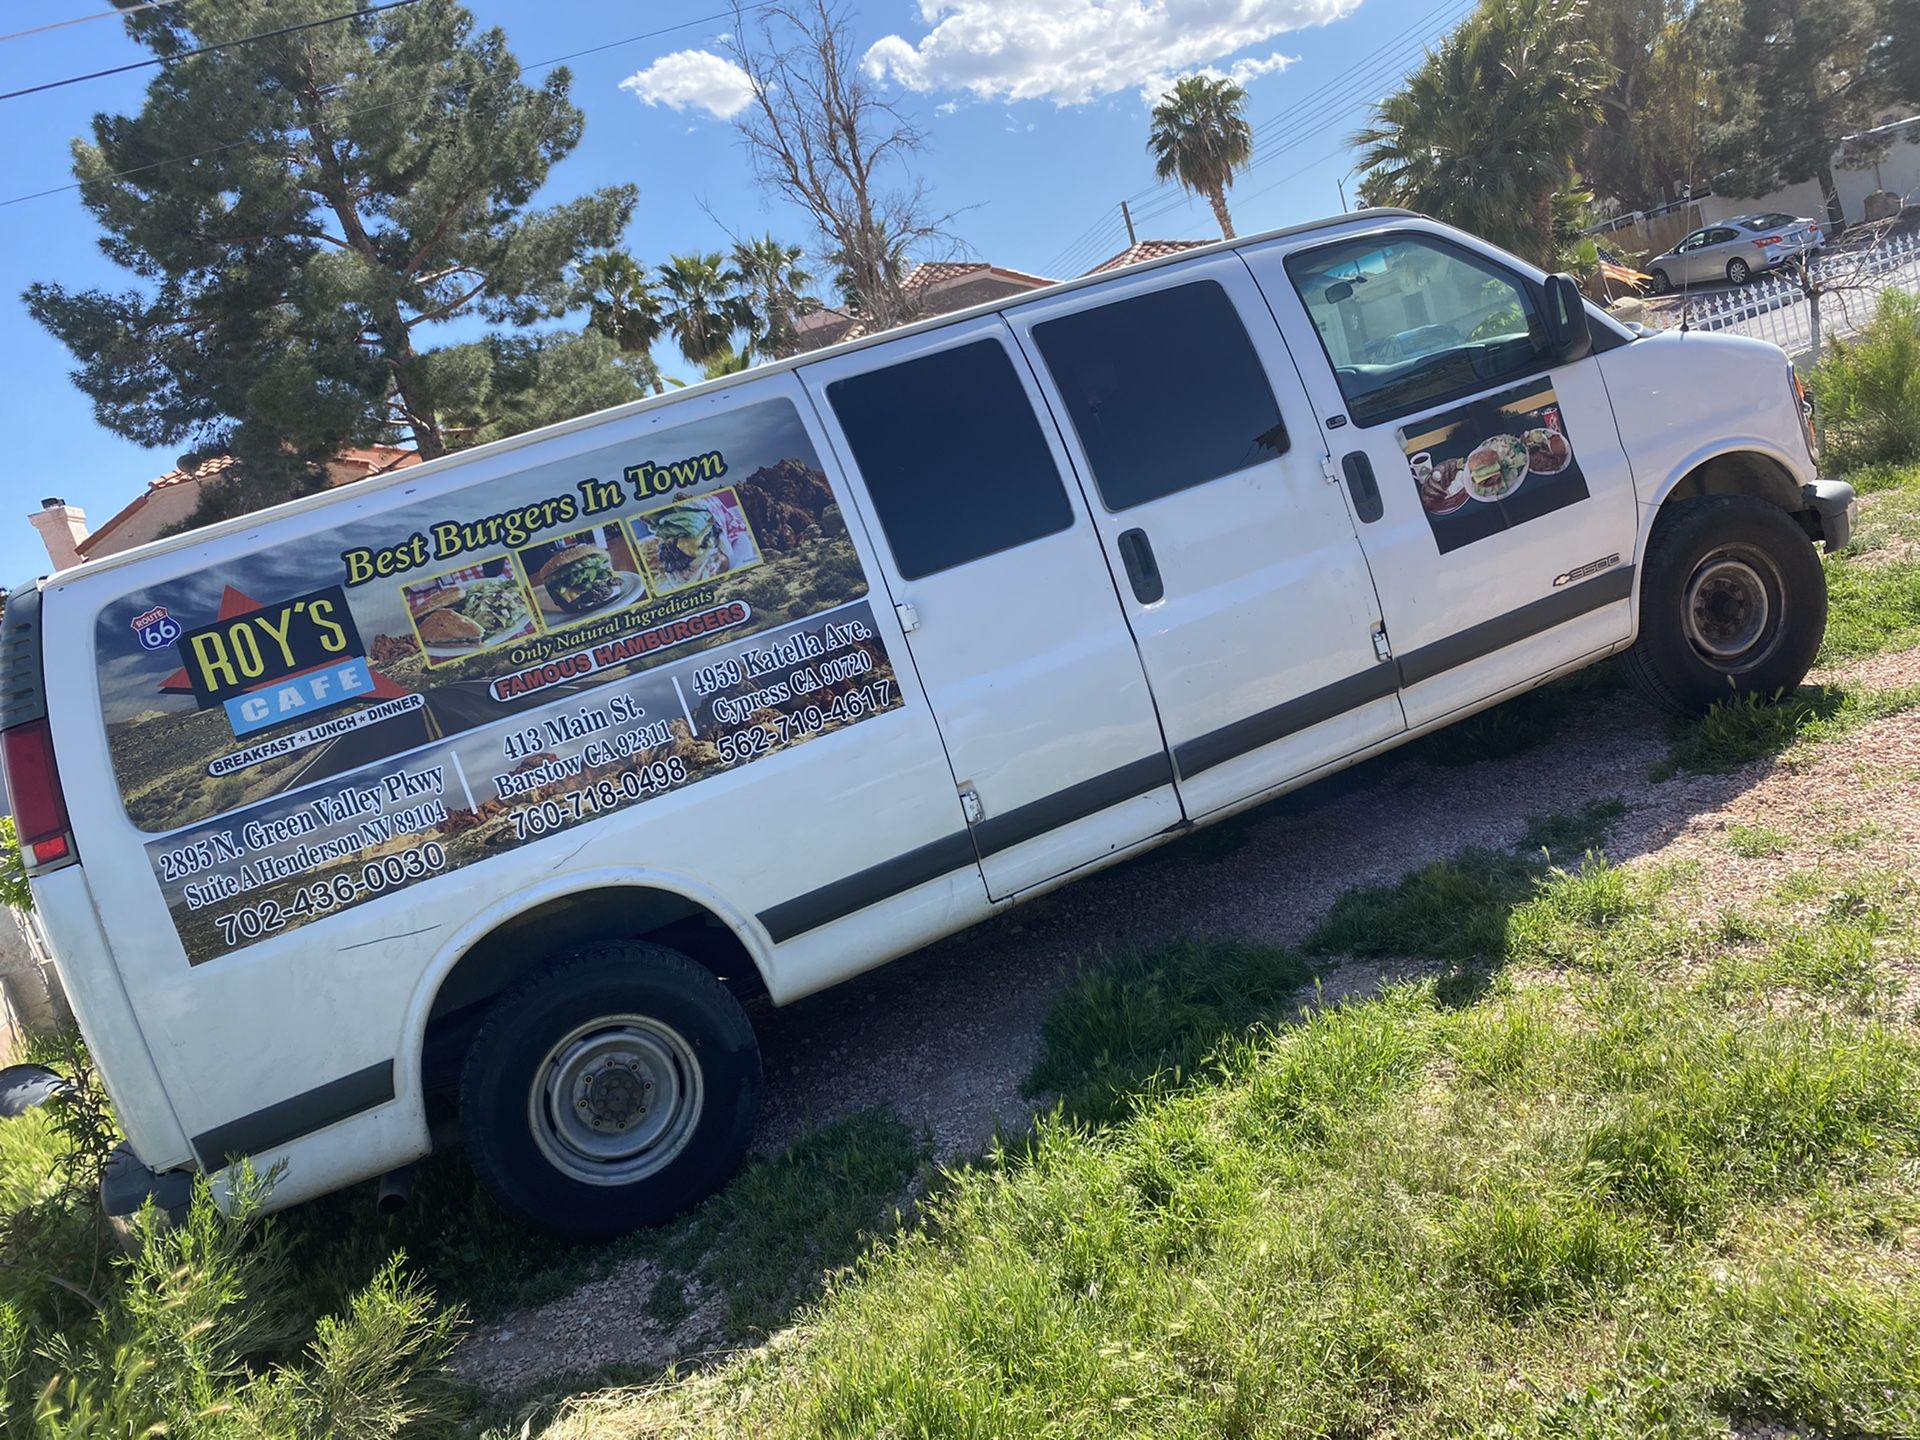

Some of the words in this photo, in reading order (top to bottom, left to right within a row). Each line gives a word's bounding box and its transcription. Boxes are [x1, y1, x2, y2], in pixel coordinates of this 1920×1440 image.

[345, 534, 427, 585] Best
[434, 496, 576, 546] Burgers
[581, 481, 623, 513] In
[627, 453, 725, 498] Town
[135, 609, 165, 628] ROUTE
[145, 620, 176, 646] 66
[190, 599, 347, 693] ROY'S
[495, 653, 592, 700] FAMOUS
[593, 603, 746, 667] HAMBURGERS
[511, 639, 552, 665] Only
[556, 617, 620, 649] Natural
[625, 591, 713, 628] Ingredients
[693, 659, 741, 694] 4959
[741, 631, 823, 678] Katella
[825, 620, 872, 649] Ave.
[239, 666, 363, 722] CAFE
[713, 681, 790, 724] Cypress
[790, 667, 823, 695] CA
[820, 650, 872, 684] 90720
[717, 680, 890, 763] 562-719-4617
[213, 736, 298, 774] BREAKFAST
[309, 715, 358, 742] LUNCH
[367, 695, 421, 722] DINNER
[494, 755, 581, 799] Barstow
[584, 740, 618, 767] CA
[616, 720, 673, 757] 92311
[504, 727, 543, 760] 413
[544, 708, 609, 746] Main
[610, 694, 645, 724] St.
[159, 840, 214, 882] 2895
[211, 830, 245, 863] N.
[243, 810, 316, 852] Green
[312, 786, 382, 827] Valley
[383, 766, 444, 802] Pkwy
[509, 756, 686, 839] 760-718-0498
[184, 874, 240, 910] Suite
[241, 865, 259, 892] A
[255, 833, 363, 884] Henderson
[359, 814, 392, 846] NV
[393, 799, 448, 835] 89104
[215, 841, 446, 946] 702-436-0030
